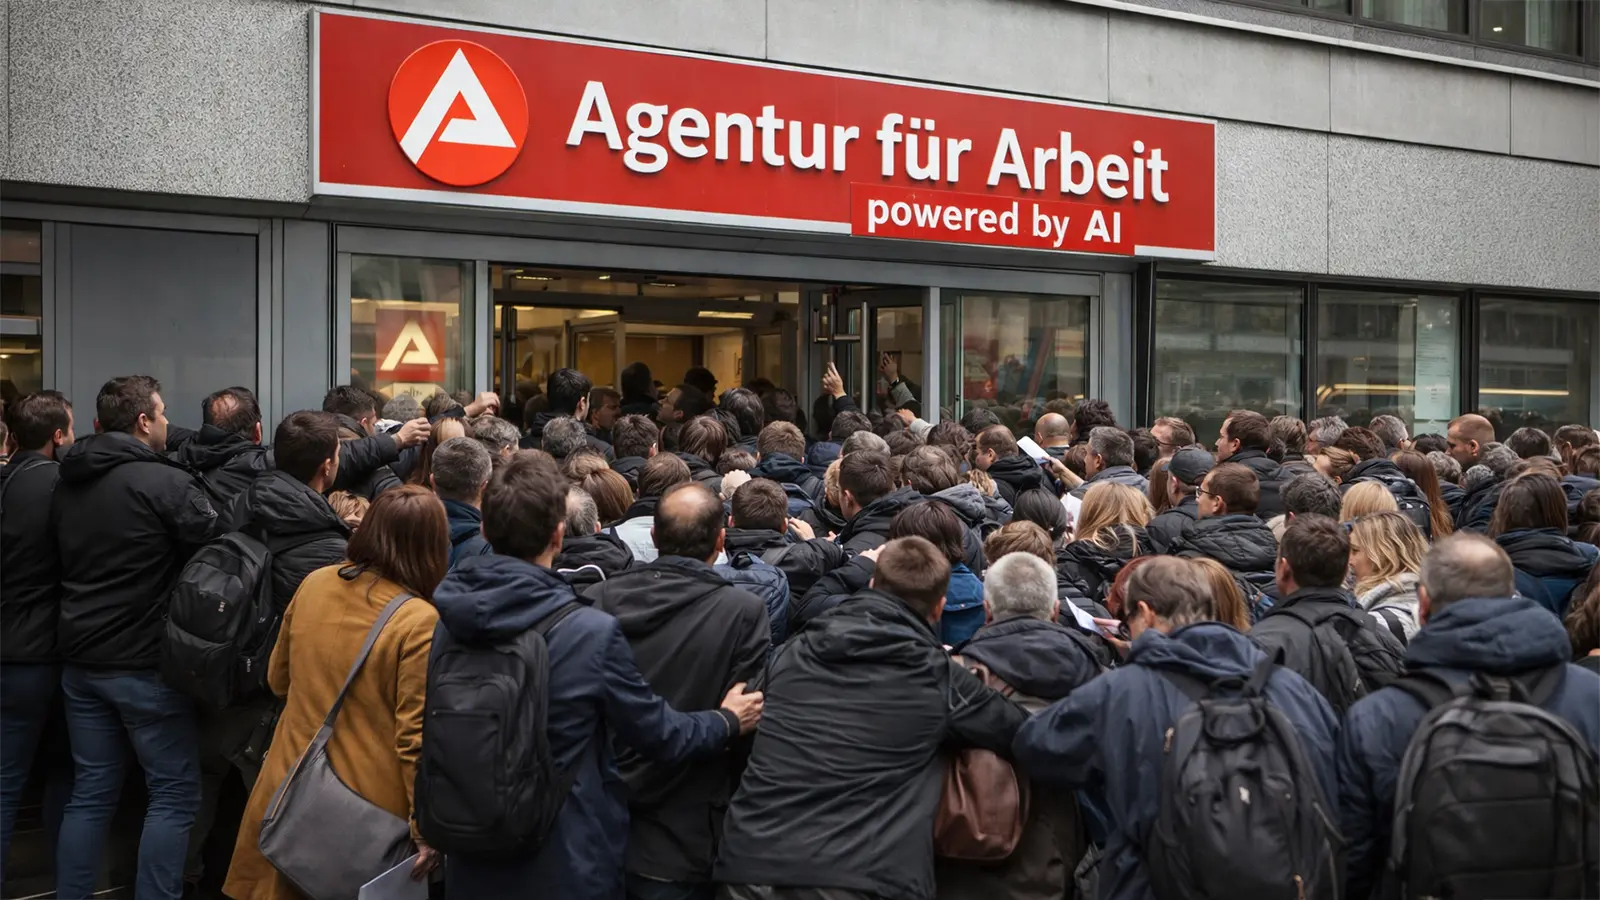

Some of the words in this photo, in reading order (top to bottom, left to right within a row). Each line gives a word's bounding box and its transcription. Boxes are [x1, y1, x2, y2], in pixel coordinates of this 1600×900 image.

[566, 79, 860, 174] Agentur
[876, 111, 972, 183] für
[987, 126, 1170, 204] Arbeit
[866, 198, 1020, 236] powered
[1032, 202, 1071, 249] by
[1083, 209, 1122, 244] AI
